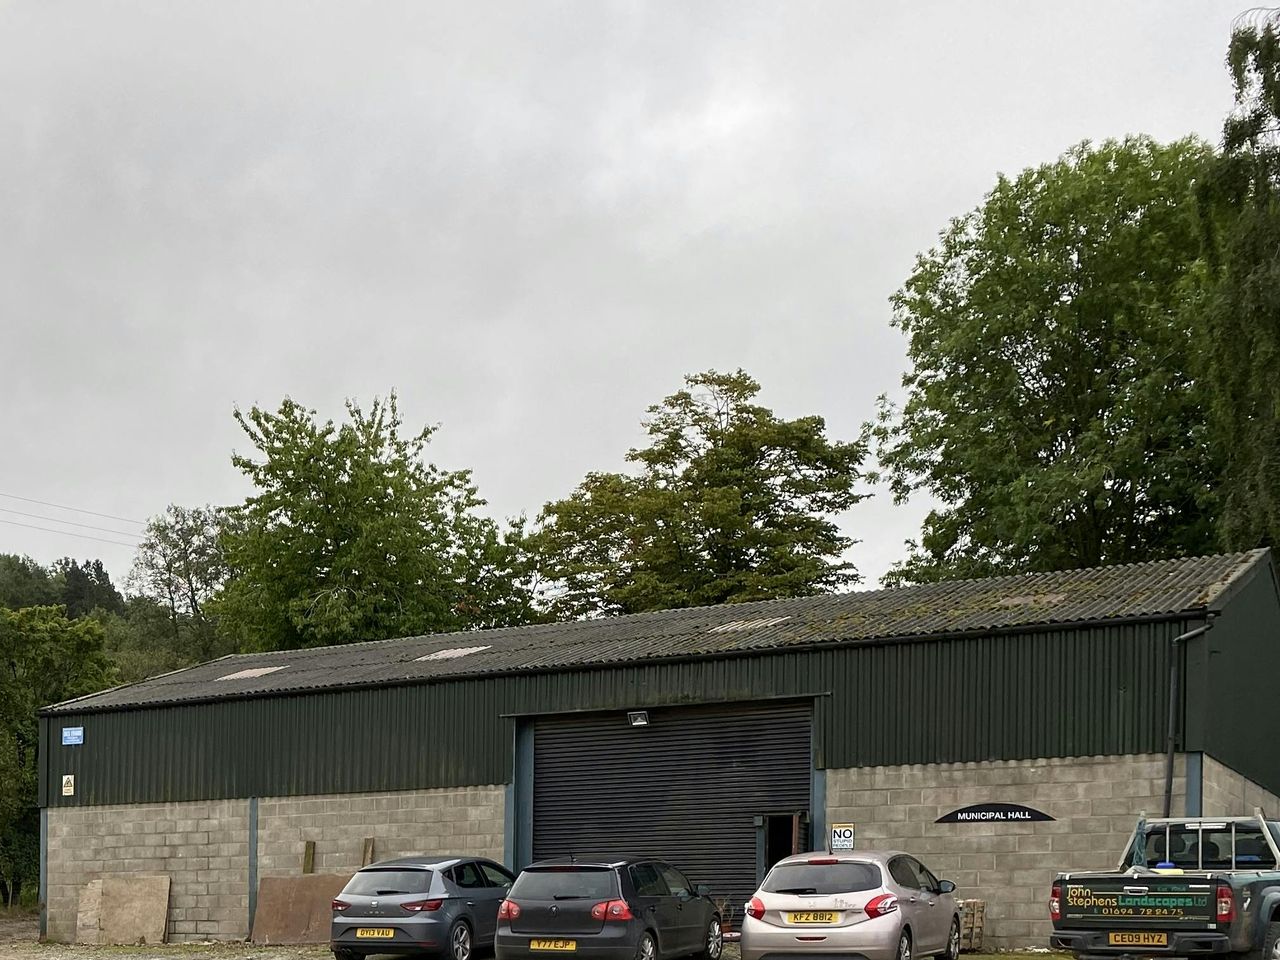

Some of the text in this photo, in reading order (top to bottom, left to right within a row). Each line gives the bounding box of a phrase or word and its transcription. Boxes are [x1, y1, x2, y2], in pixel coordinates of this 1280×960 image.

[957, 811, 1032, 820] MUNICIPAL HALL
[833, 829, 853, 839] NO
[1067, 895, 1208, 908] stephens Landscapes Ltd
[793, 913, 811, 921] KFZ
[1114, 933, 1163, 943] CE09 HYZ
[536, 941, 571, 949] Y77 EJP
